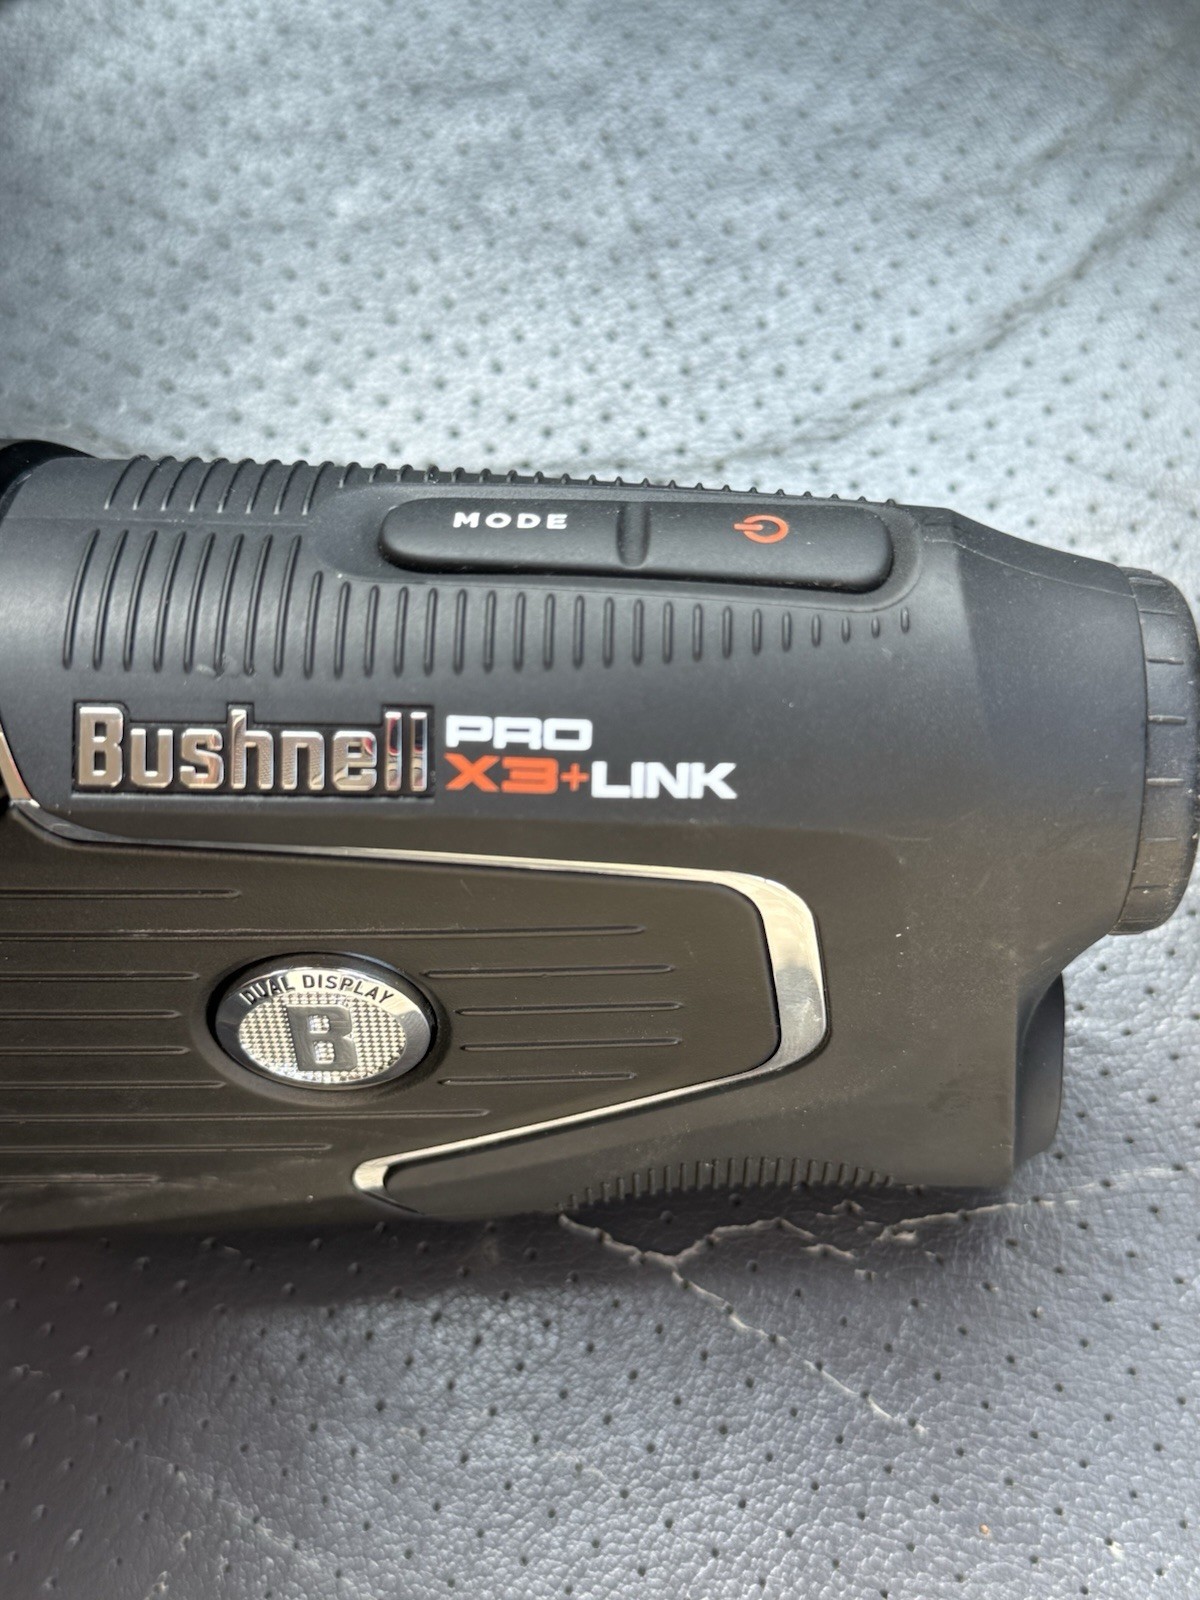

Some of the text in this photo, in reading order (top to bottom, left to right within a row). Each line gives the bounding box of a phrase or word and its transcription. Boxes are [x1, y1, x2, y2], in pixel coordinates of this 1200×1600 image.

[452, 511, 568, 530] MODE
[78, 706, 428, 792] Bushnell
[446, 715, 593, 751] PRO
[239, 974, 395, 1006] DUAL DISPLAY
[286, 1006, 358, 1072] B
